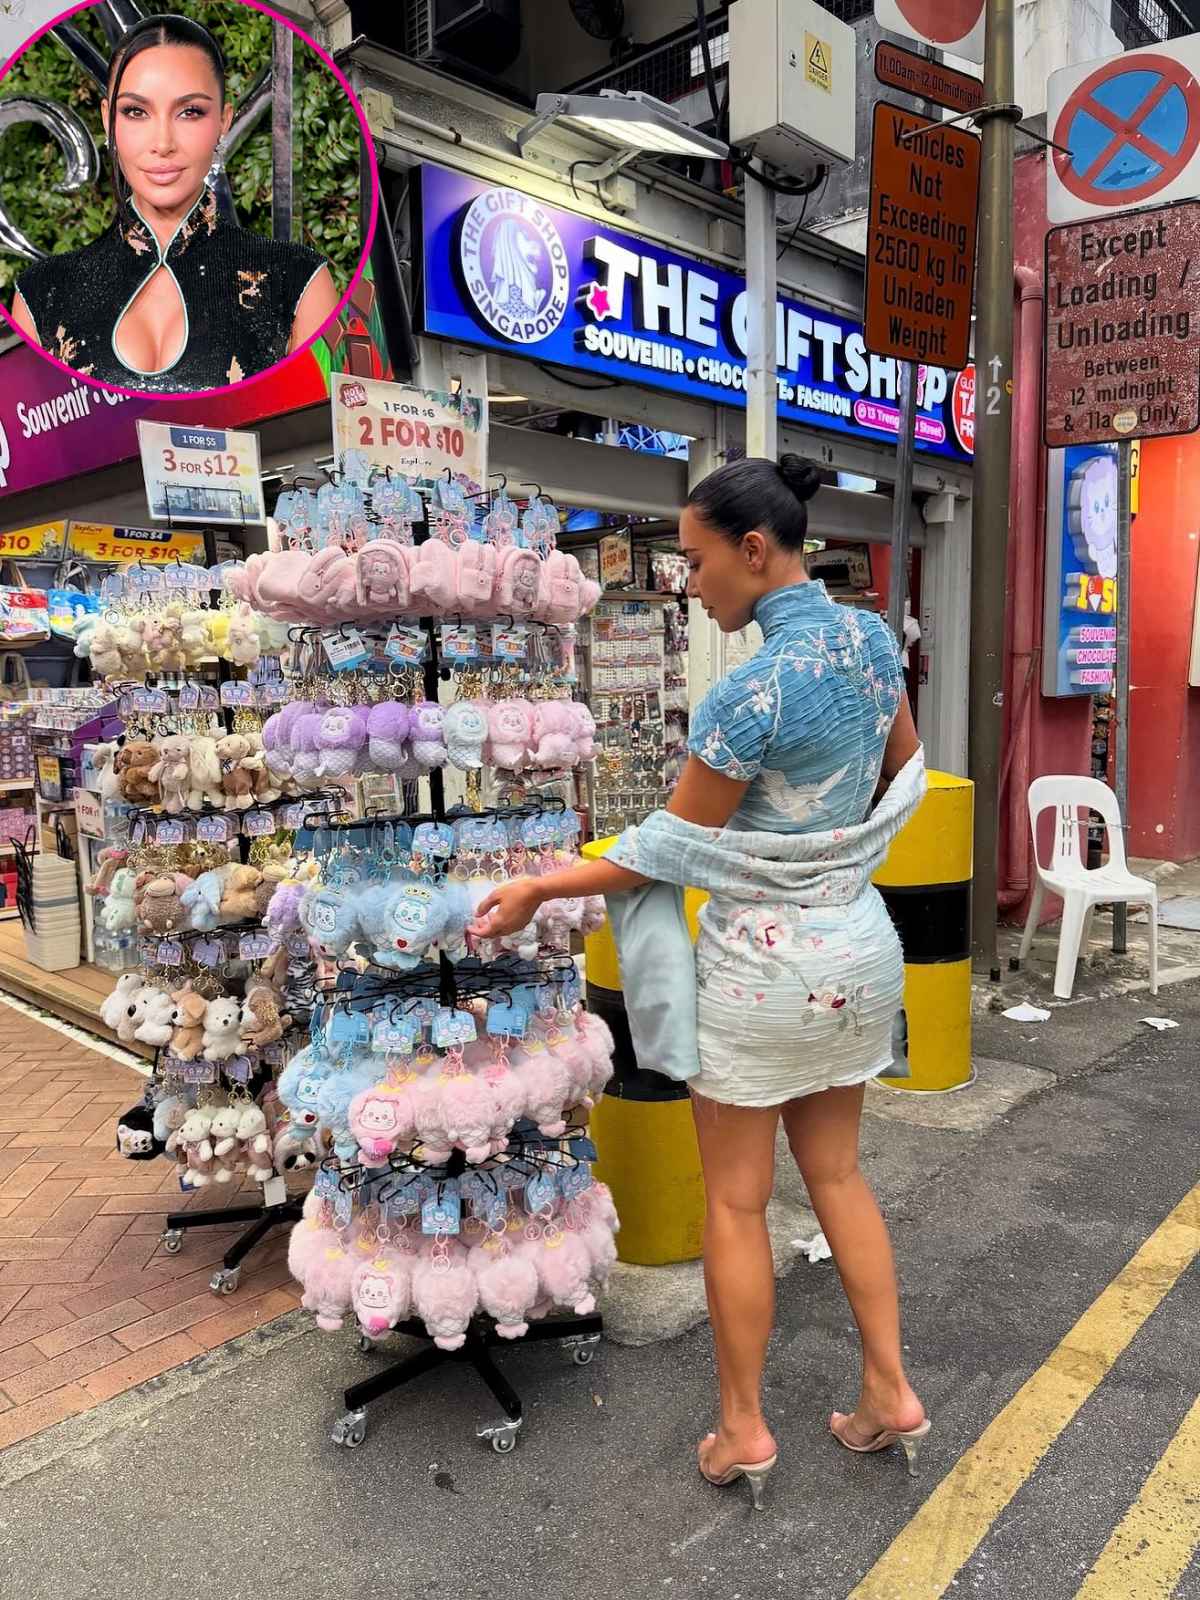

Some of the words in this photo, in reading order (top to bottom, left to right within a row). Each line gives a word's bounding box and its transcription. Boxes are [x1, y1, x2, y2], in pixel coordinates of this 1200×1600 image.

[892, 116, 964, 169] Vehicles
[910, 163, 943, 200] Not
[464, 208, 484, 257] THE
[486, 191, 528, 213] GIFT
[532, 210, 566, 279] SHOP
[879, 194, 967, 253] Exceeding
[1081, 219, 1167, 261] Except
[875, 232, 919, 272] 2500
[926, 247, 945, 287] kg
[951, 255, 967, 285] In
[470, 279, 565, 340] SINGAPORE
[595, 236, 718, 346] THE
[883, 275, 955, 321] Unladen
[1057, 270, 1157, 308] Loading
[889, 315, 947, 358] Weight
[1057, 309, 1190, 348] Unloading
[584, 325, 684, 373] SOUVENIR
[797, 385, 850, 416] FASHION
[1085, 354, 1159, 378] Between
[17, 377, 90, 438] Souvenir
[384, 402, 389, 411] 1
[394, 404, 419, 416] FOR
[422, 409, 435, 418] $6
[1070, 386, 1086, 406] 12
[1098, 376, 1176, 402] midnight
[358, 416, 374, 445] 2
[380, 418, 431, 448] FOR
[436, 426, 464, 457] $10
[1087, 411, 1113, 429] 11a
[1139, 405, 1180, 428] Only
[183, 435, 188, 443] 1
[189, 436, 205, 445] FOR
[162, 449, 176, 471] 3
[180, 462, 202, 473] FOR
[204, 454, 240, 476] $12
[96, 543, 107, 555] 3
[111, 545, 146, 557] FOR
[124, 528, 129, 537] 1
[129, 530, 149, 539] FOR
